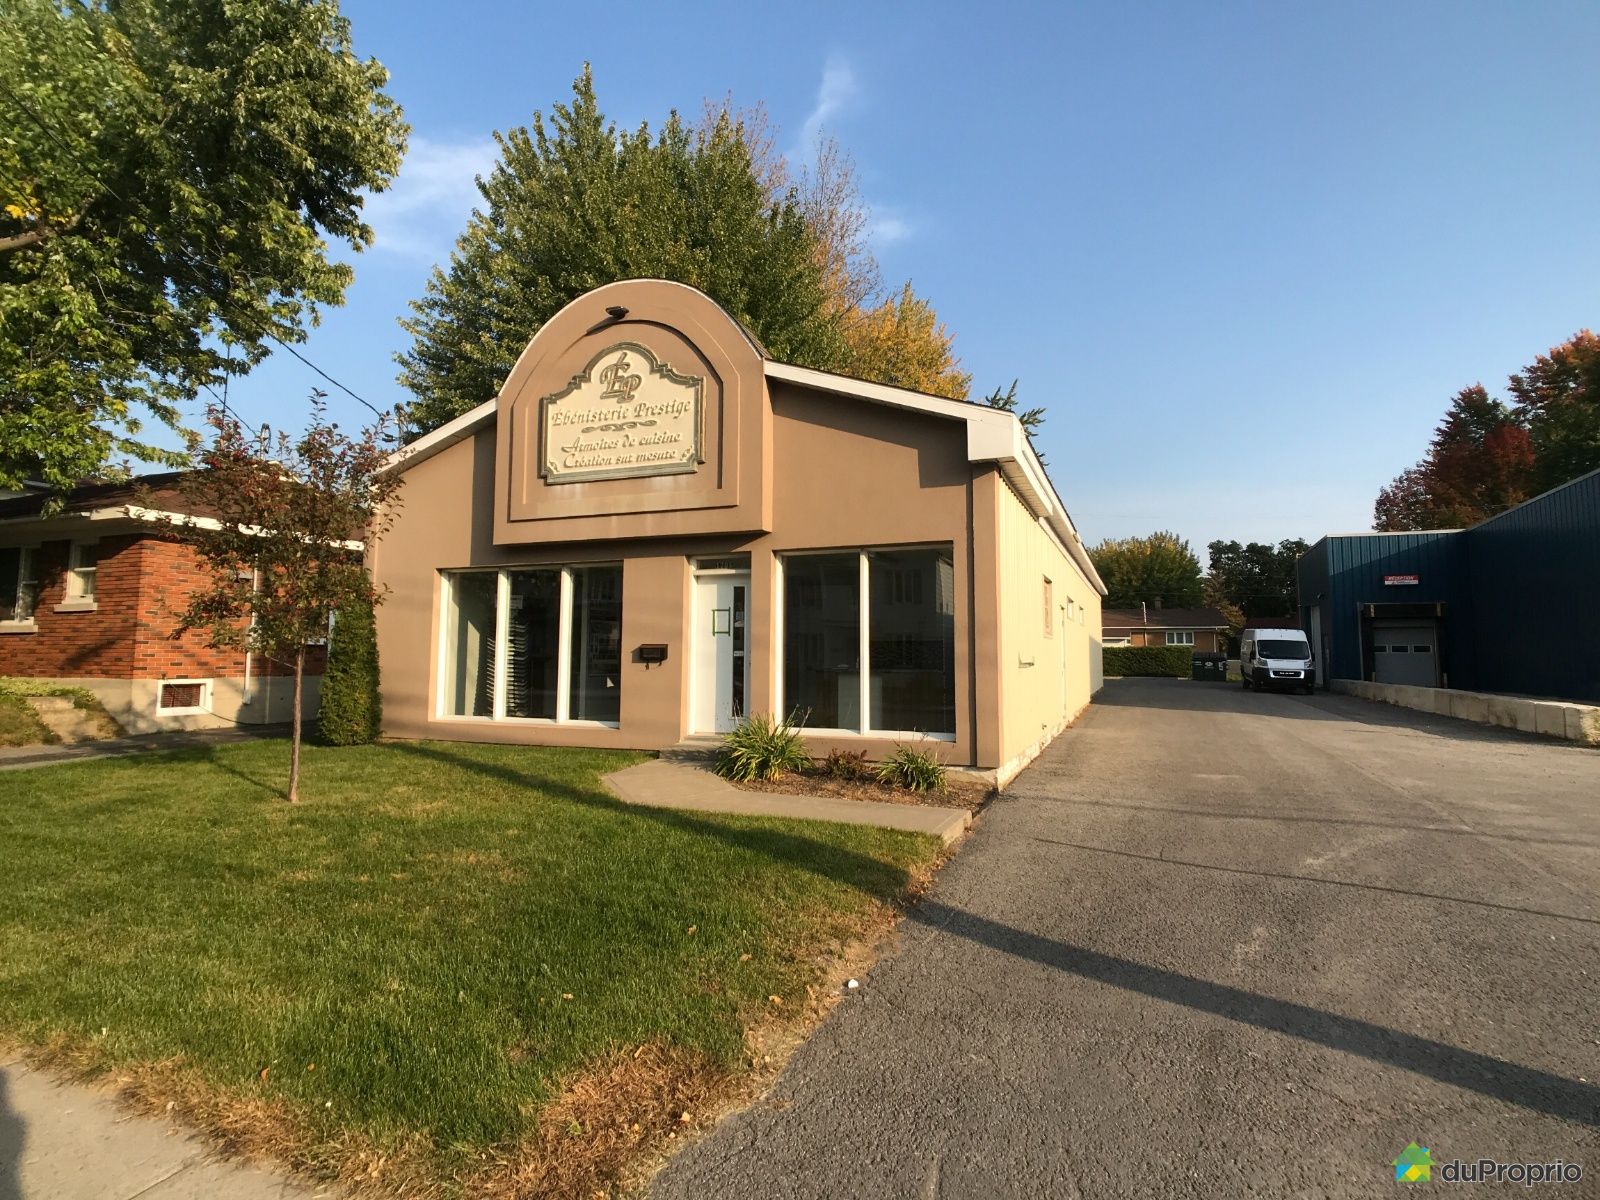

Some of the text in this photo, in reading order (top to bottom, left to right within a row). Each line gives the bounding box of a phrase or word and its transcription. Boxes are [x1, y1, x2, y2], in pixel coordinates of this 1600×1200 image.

[634, 399, 691, 419] Prestige
[561, 431, 681, 453] Armoires de cuisine
[563, 450, 676, 469] Création sur mesure
